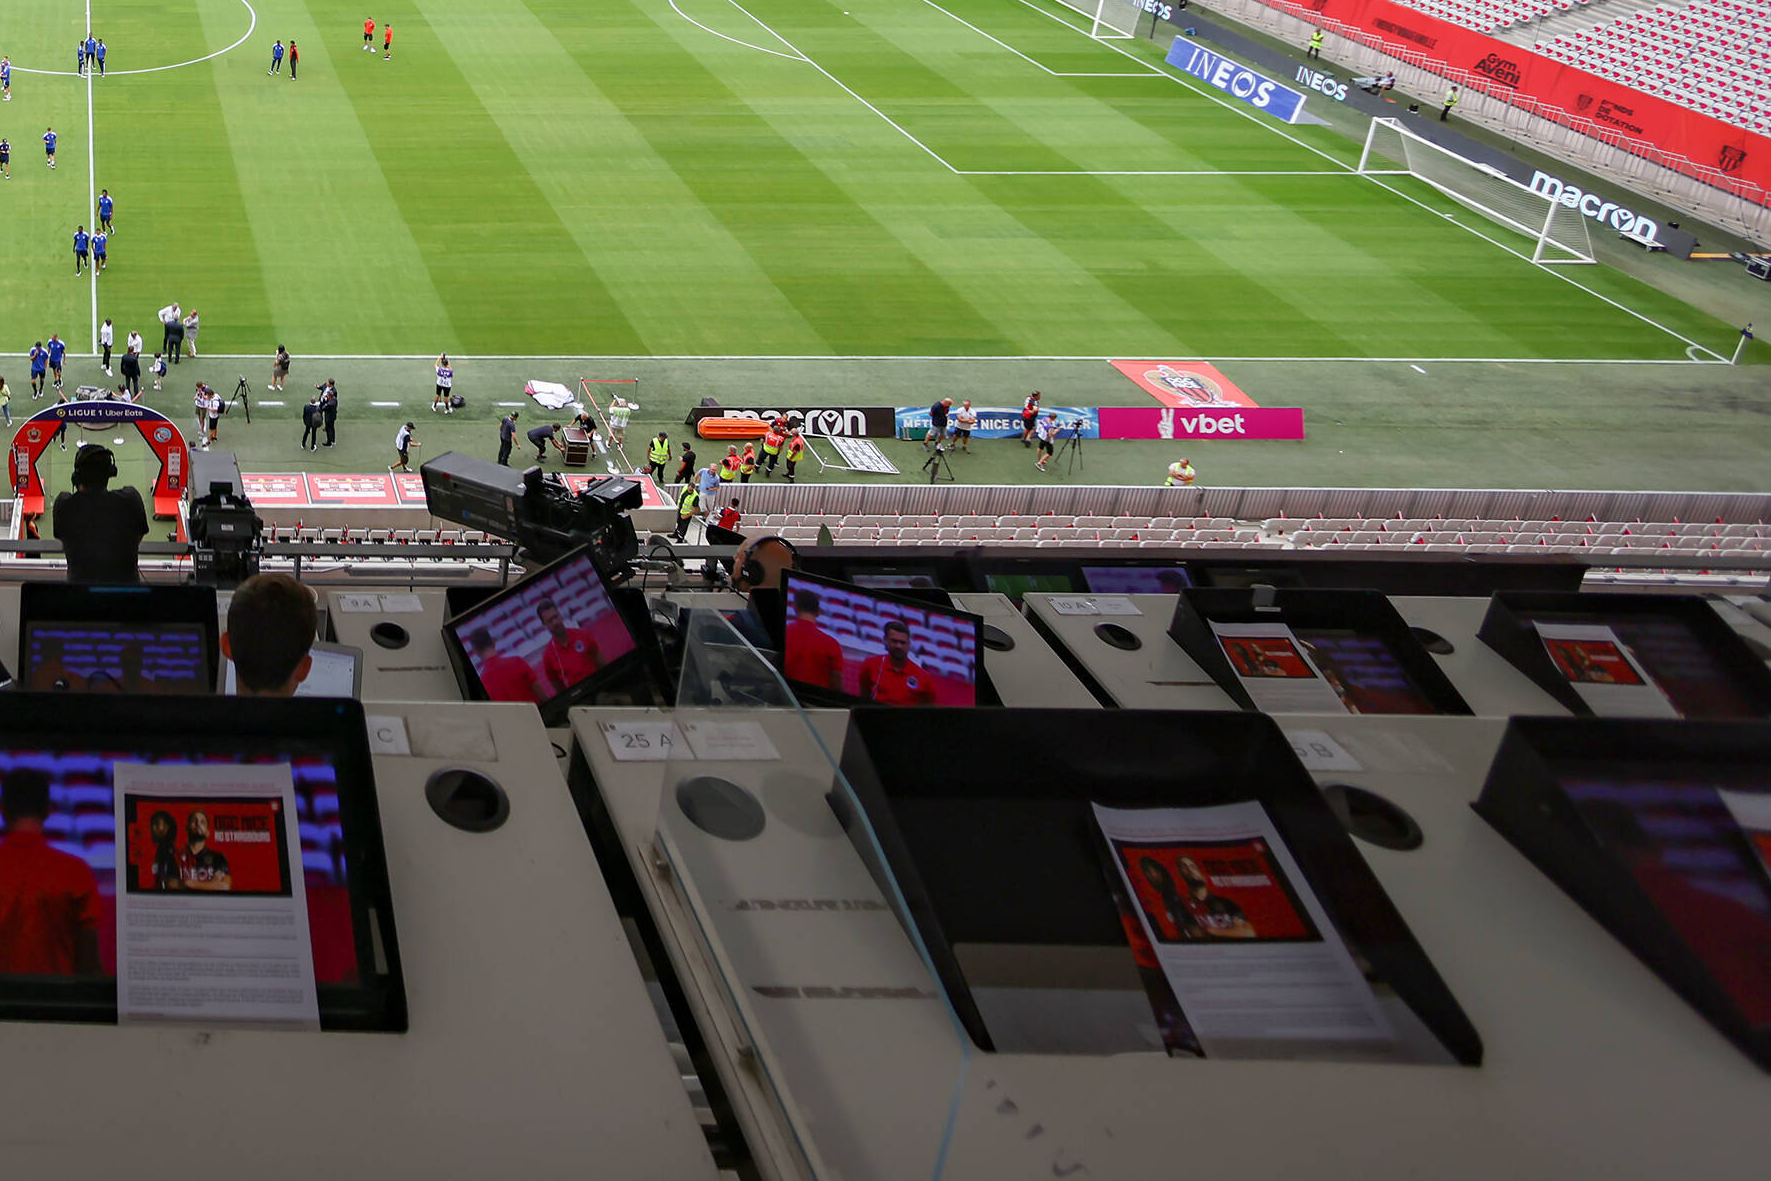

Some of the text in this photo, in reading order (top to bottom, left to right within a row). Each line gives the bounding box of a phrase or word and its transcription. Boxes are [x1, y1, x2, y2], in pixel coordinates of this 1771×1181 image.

[1486, 53, 1518, 71] Gym
[1185, 47, 1277, 108] INEOS
[1294, 65, 1349, 102] INEOS
[1598, 105, 1611, 115] DE
[1595, 112, 1644, 134] DOTATION
[1530, 170, 1659, 243] macron
[124, 409, 143, 417] Eats
[980, 419, 1009, 430] NICE
[1180, 413, 1246, 434] vbet
[377, 728, 393, 742] C
[621, 734, 673, 748] 25 A
